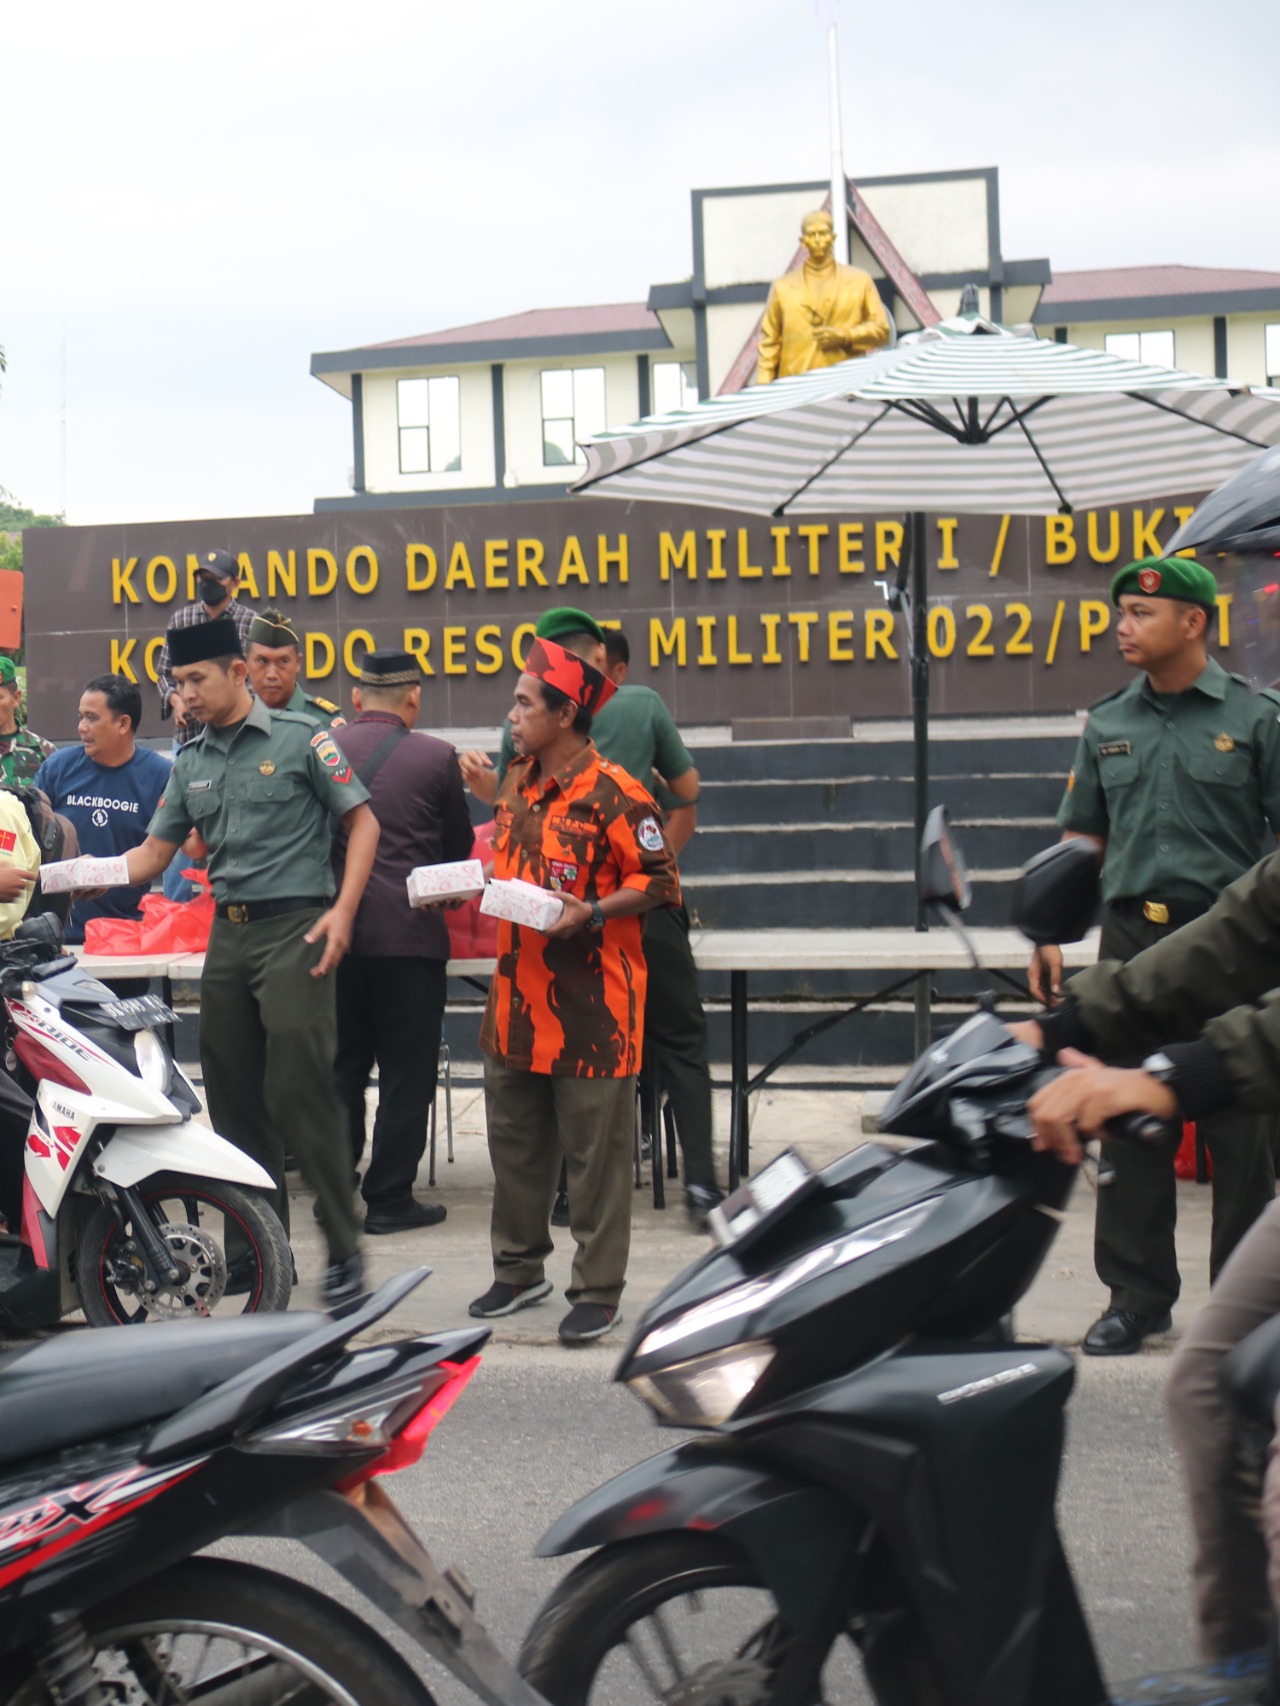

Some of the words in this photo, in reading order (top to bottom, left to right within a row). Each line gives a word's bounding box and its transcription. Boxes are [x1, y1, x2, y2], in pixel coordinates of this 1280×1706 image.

[406, 533, 629, 591] DAERAH
[659, 520, 904, 581] MILITER
[649, 608, 899, 668] MILITER
[66, 794, 139, 814] BLACKBOOGIE
